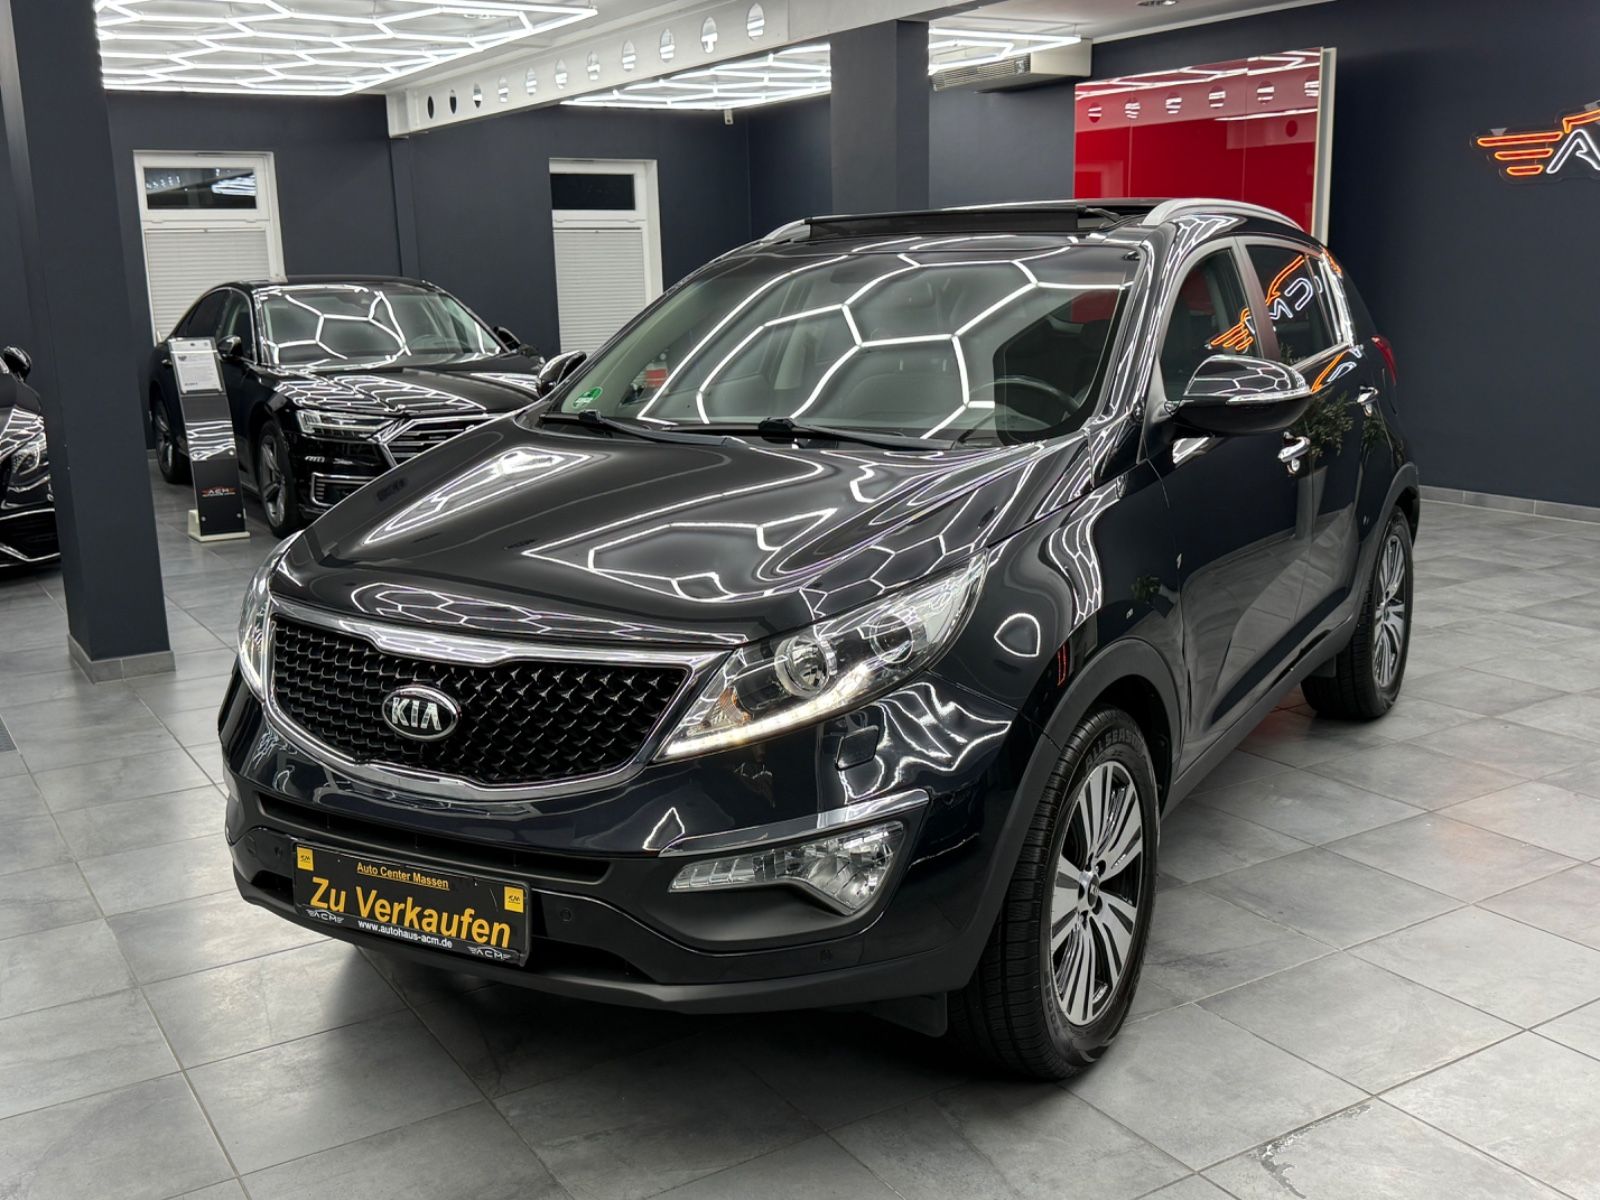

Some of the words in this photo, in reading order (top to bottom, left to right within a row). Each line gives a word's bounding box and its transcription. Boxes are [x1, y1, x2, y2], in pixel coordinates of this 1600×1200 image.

[392, 697, 442, 731] KIA
[356, 861, 378, 875] Auto
[380, 866, 411, 881] Center
[412, 871, 449, 889] Massen
[310, 876, 347, 913] Zu
[355, 886, 511, 948] Verkaufen
[358, 919, 453, 949] www.autohaus-acm.de
